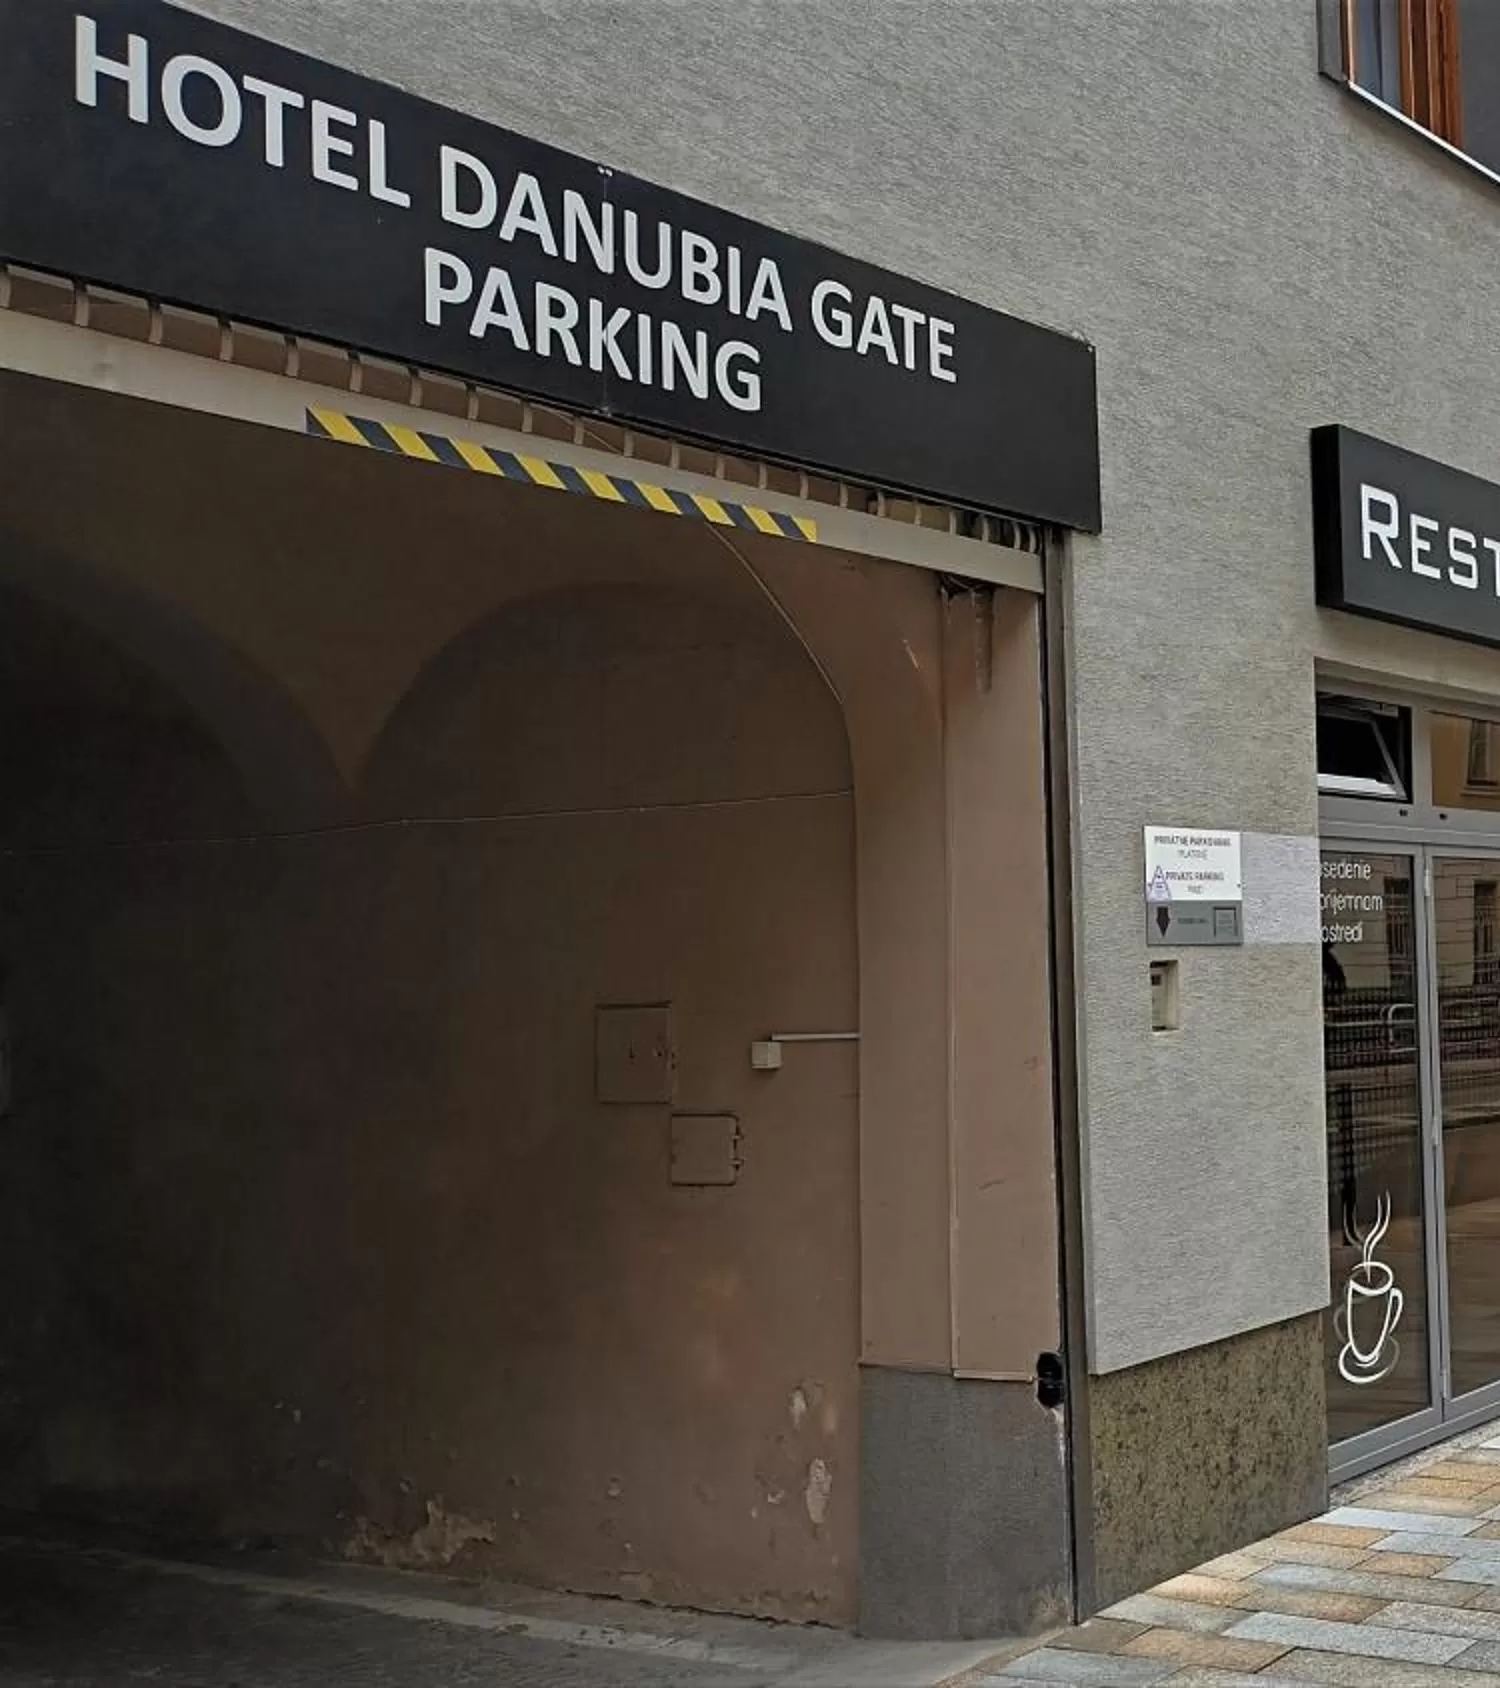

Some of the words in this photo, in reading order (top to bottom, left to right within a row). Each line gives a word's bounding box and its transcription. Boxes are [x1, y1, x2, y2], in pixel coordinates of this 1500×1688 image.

[74, 15, 411, 208] HOTEL
[440, 145, 792, 332] DANUBIA
[810, 278, 957, 383] GATE
[424, 247, 763, 411] PARKING
